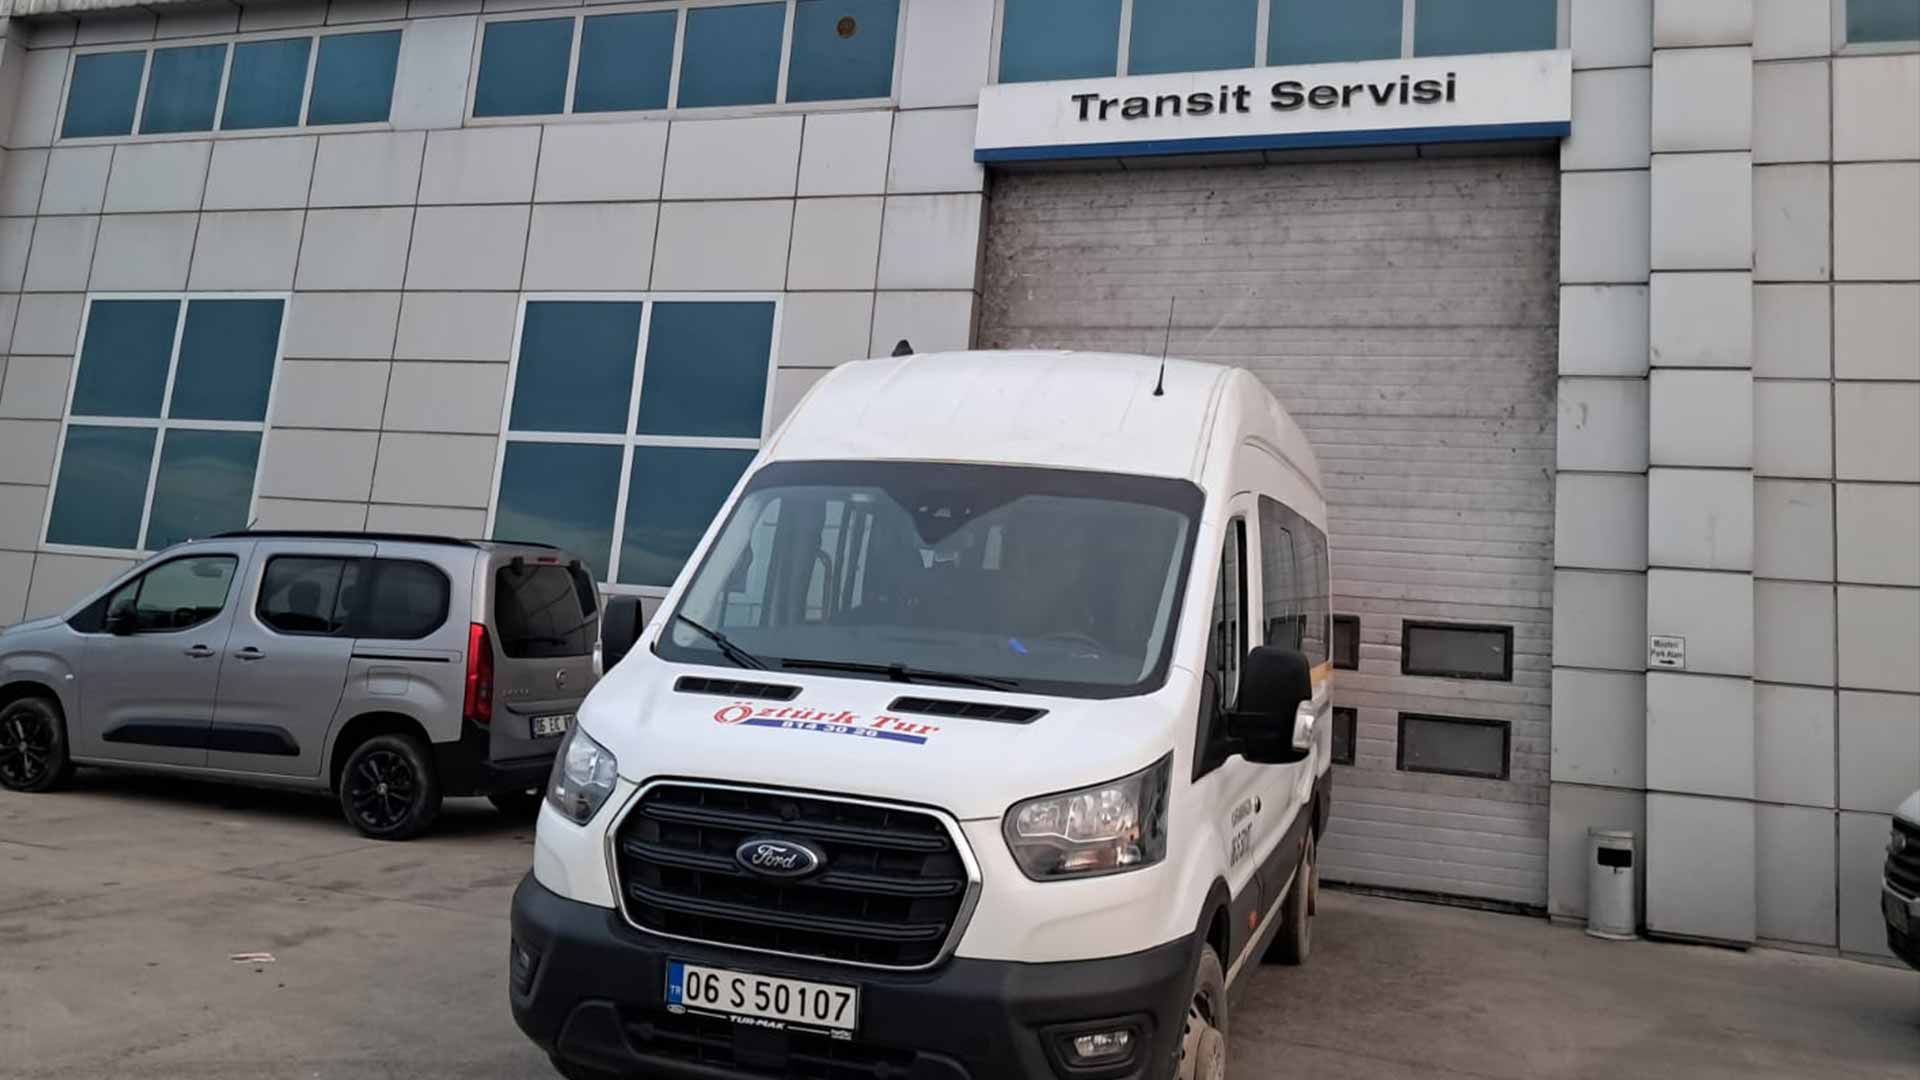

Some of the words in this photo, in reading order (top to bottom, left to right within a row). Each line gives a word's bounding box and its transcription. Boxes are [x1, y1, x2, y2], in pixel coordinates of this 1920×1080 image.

[1071, 83, 1251, 122] Transit
[1269, 72, 1457, 111] Servisi
[713, 701, 861, 724] Öztürk
[871, 715, 940, 734] Tur
[752, 844, 798, 868] Ford
[686, 971, 720, 1003] 06
[730, 978, 746, 1007] S
[754, 981, 851, 1021] 50107
